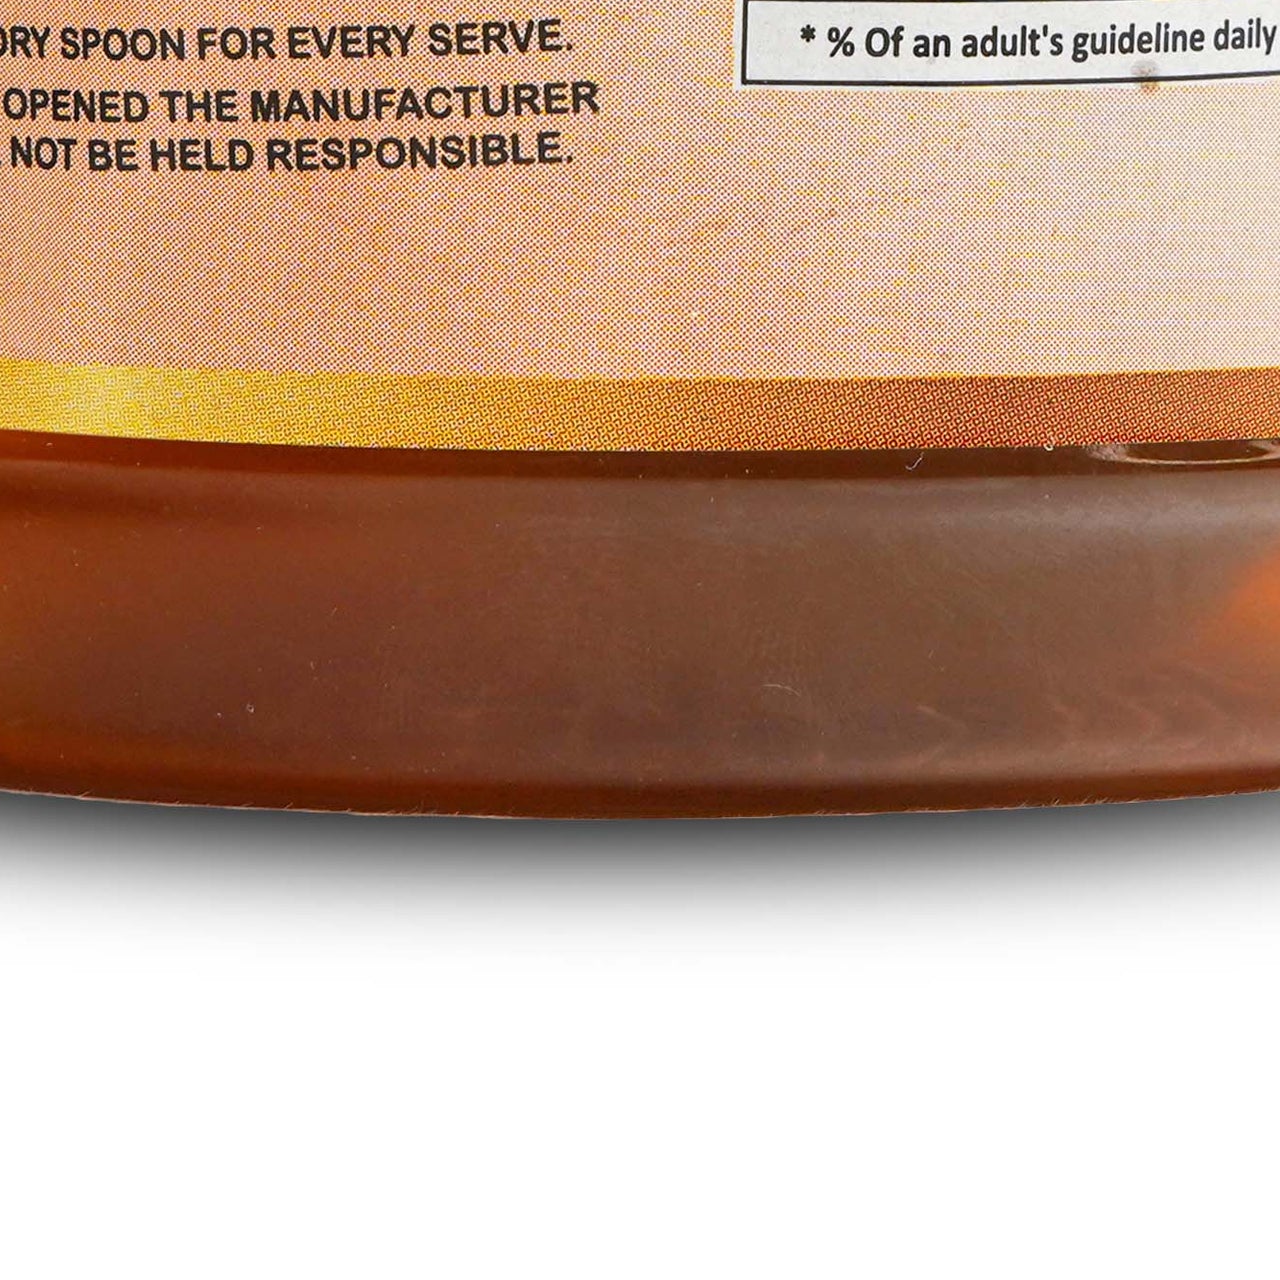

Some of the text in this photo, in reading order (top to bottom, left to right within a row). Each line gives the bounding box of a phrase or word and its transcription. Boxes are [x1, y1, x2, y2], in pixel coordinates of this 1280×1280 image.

[61, 27, 185, 61] SPOON
[197, 27, 275, 60] FOR
[288, 25, 415, 59] EVERY
[429, 19, 575, 56] SERVE.
[827, 27, 855, 57] %
[865, 26, 904, 57] Of
[913, 35, 951, 57] an
[962, 25, 1063, 57] adult's
[1072, 23, 1205, 63] guideline
[1214, 18, 1277, 55] daily
[3, 87, 149, 123] OPENED
[160, 90, 238, 122] THE
[251, 81, 599, 122] MANUFACTURER
[11, 136, 77, 170] NOT
[88, 139, 138, 171] BE
[150, 139, 254, 171] HELD
[266, 131, 575, 171] RESPONSIBLE.
